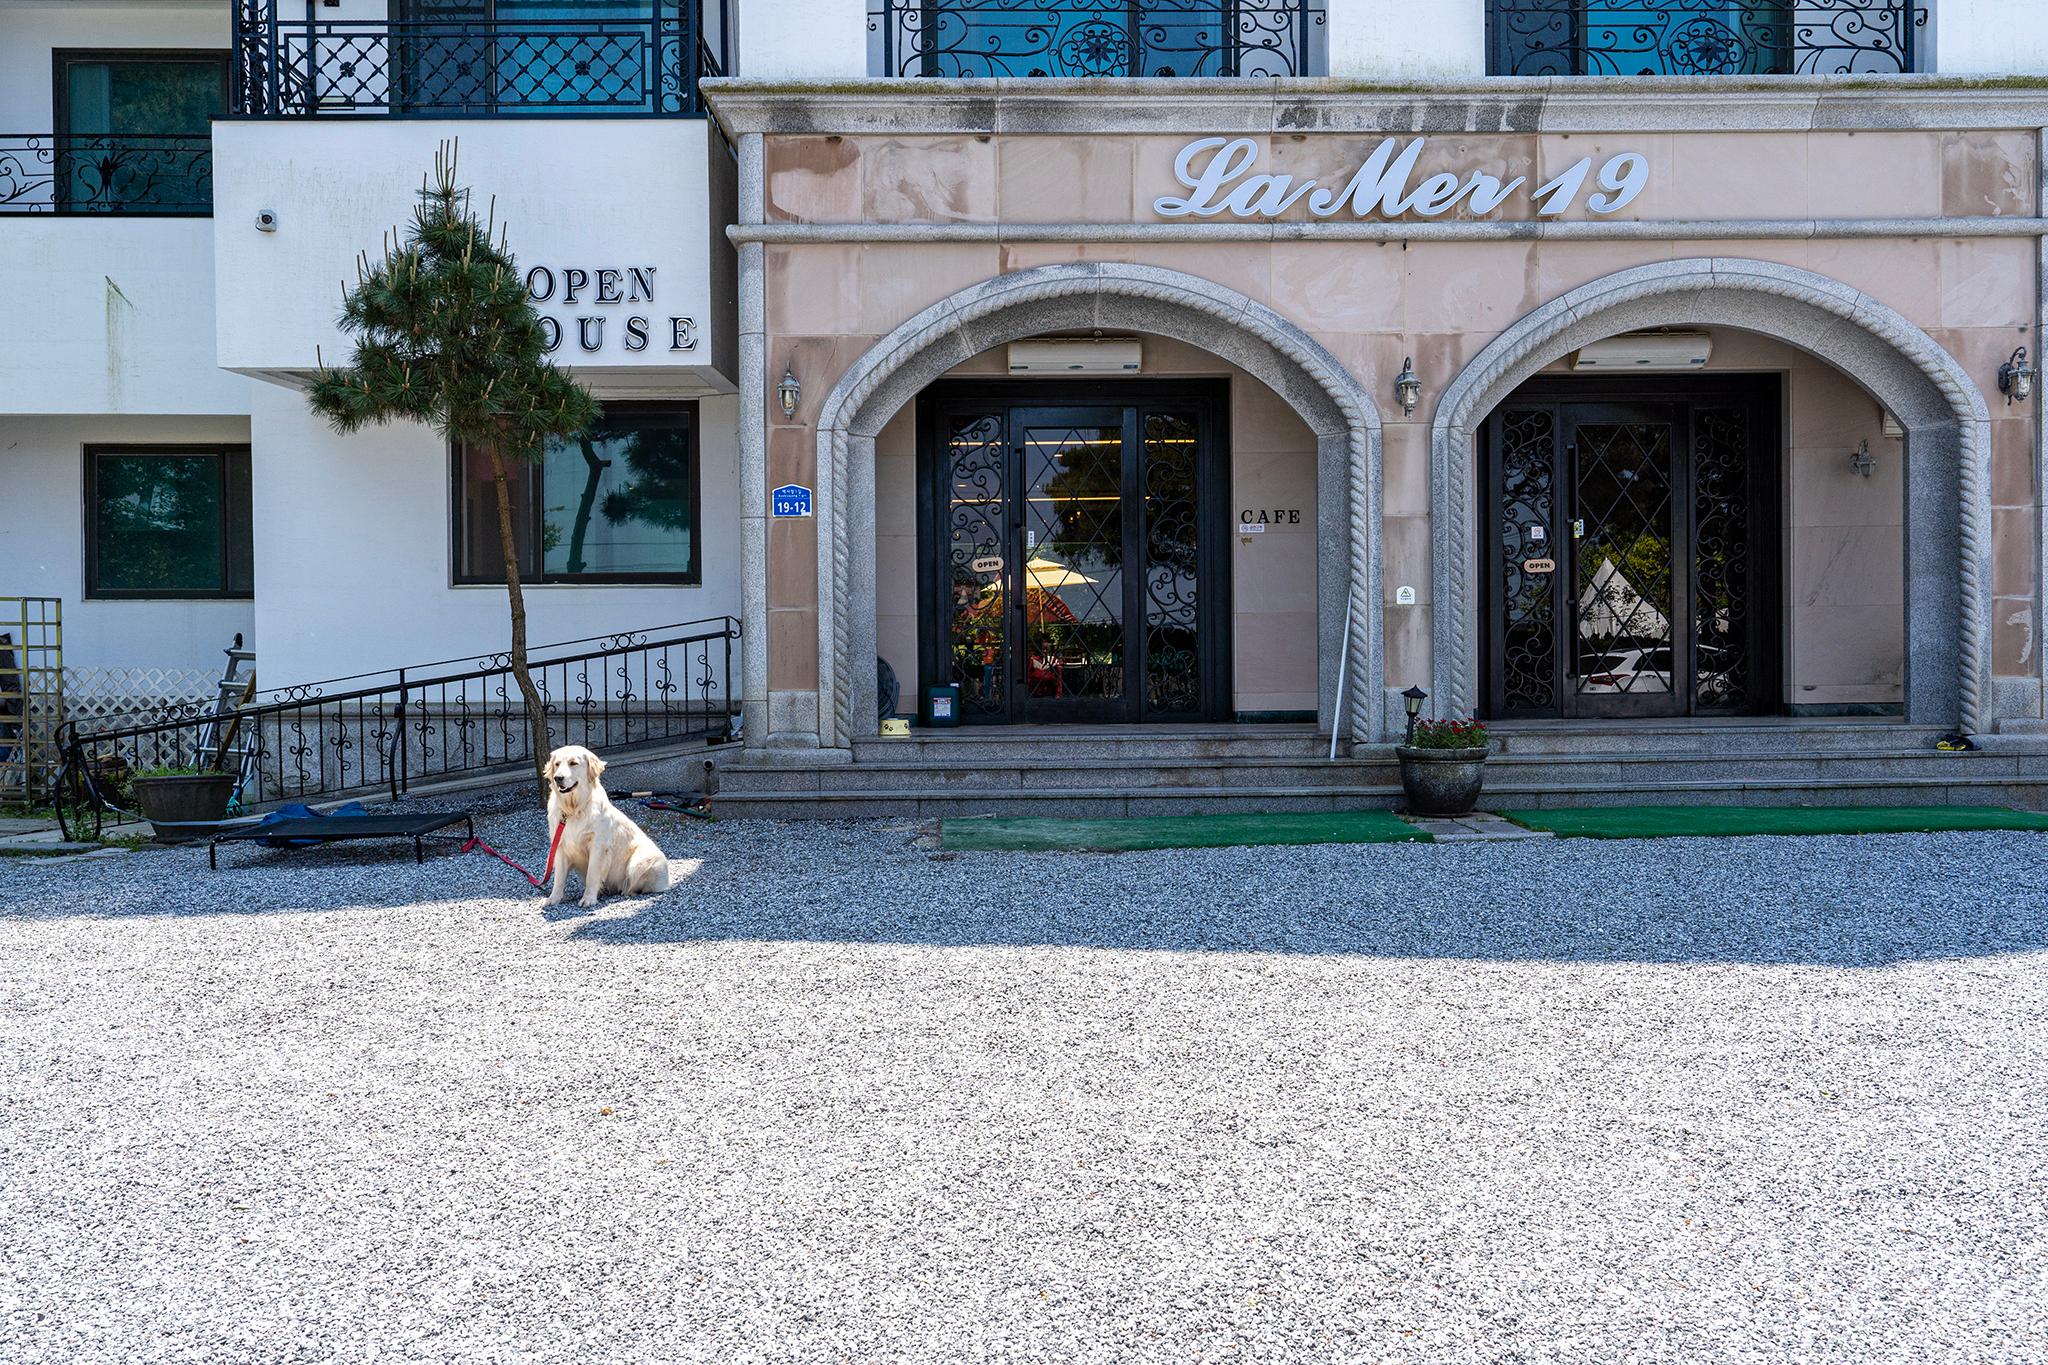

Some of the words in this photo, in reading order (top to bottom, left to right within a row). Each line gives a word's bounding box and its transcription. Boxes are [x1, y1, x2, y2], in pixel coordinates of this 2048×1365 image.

[1153, 136, 1317, 217] La
[1309, 136, 1526, 217] Mer
[1531, 152, 1650, 216] 19
[526, 266, 657, 304] OPEN
[537, 315, 699, 353] OUSE
[777, 501, 806, 513] 19-12
[1241, 509, 1300, 524] CAFE
[977, 560, 999, 568] OPEN
